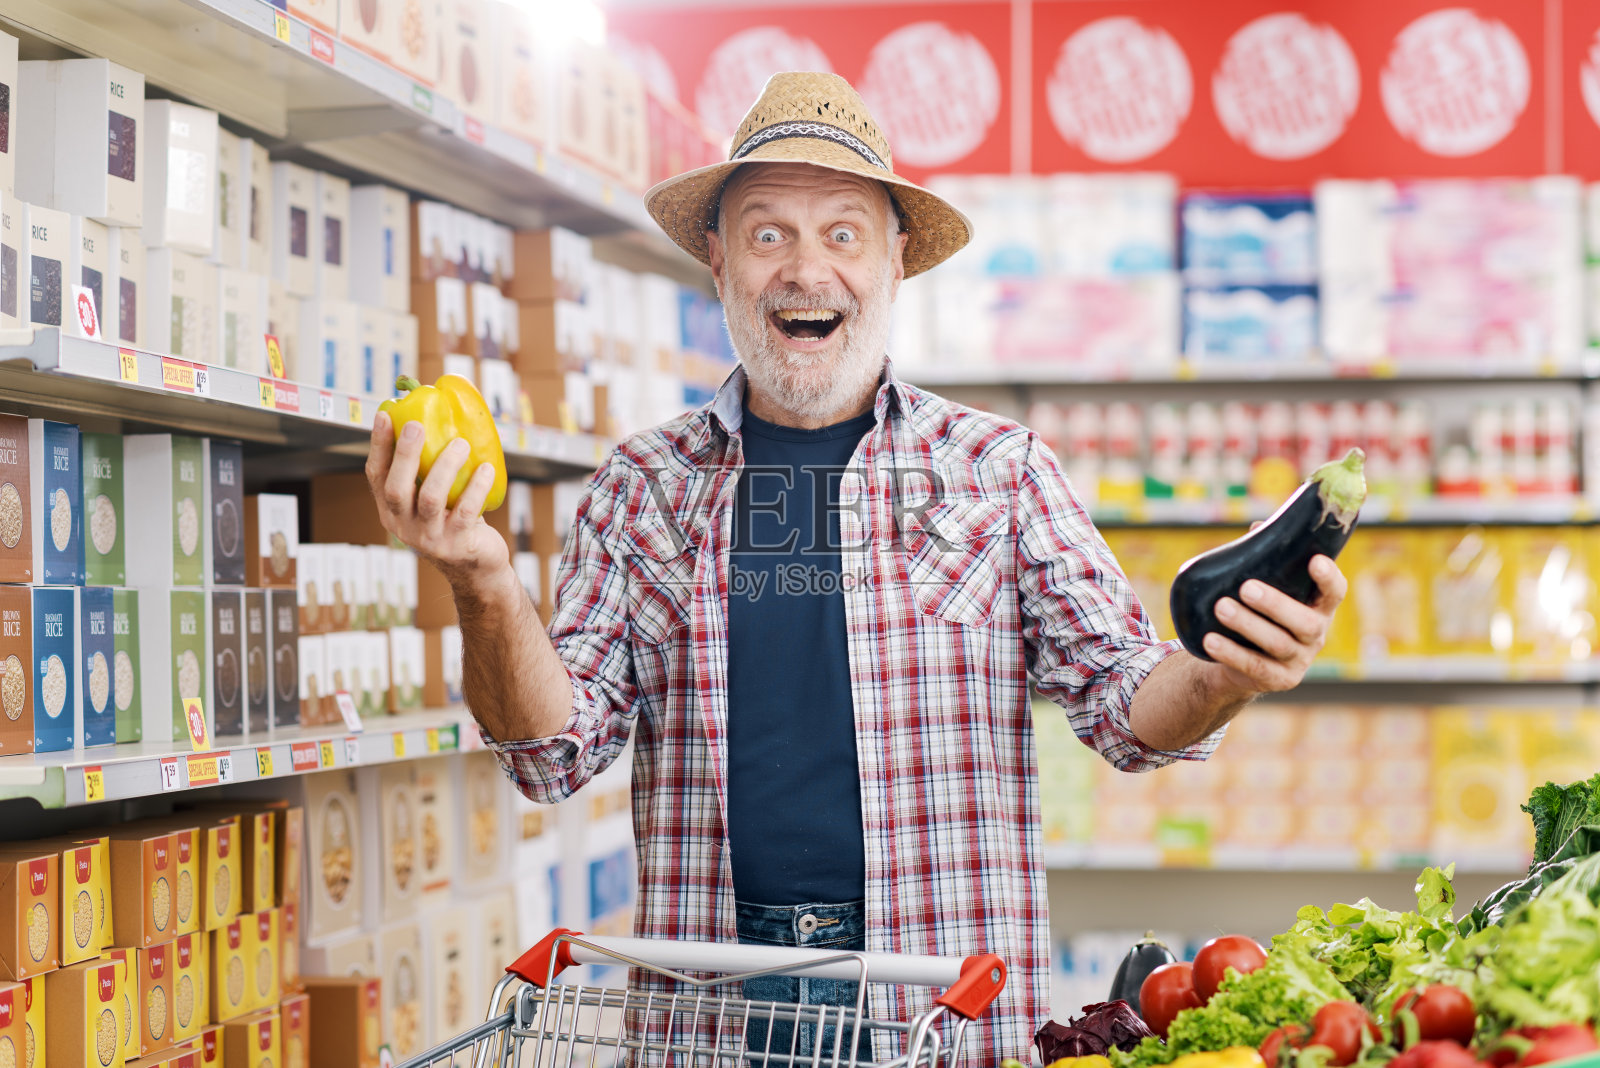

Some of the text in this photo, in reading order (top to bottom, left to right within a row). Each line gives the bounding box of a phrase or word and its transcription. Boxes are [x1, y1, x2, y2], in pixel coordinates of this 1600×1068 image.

[110, 81, 124, 98] RICE
[32, 225, 47, 241] RICE
[83, 237, 94, 253] RICE
[54, 456, 69, 471] RICE
[93, 463, 112, 479] RICE
[3, 610, 20, 620] BROWN
[45, 613, 63, 622] BASMATI
[4, 621, 21, 636] RICE
[45, 622, 63, 637] RICE
[91, 620, 105, 635] RICE
[79, 861, 88, 870] Pasta
[34, 872, 44, 882] Pasta
[102, 979, 112, 988] Pasta
